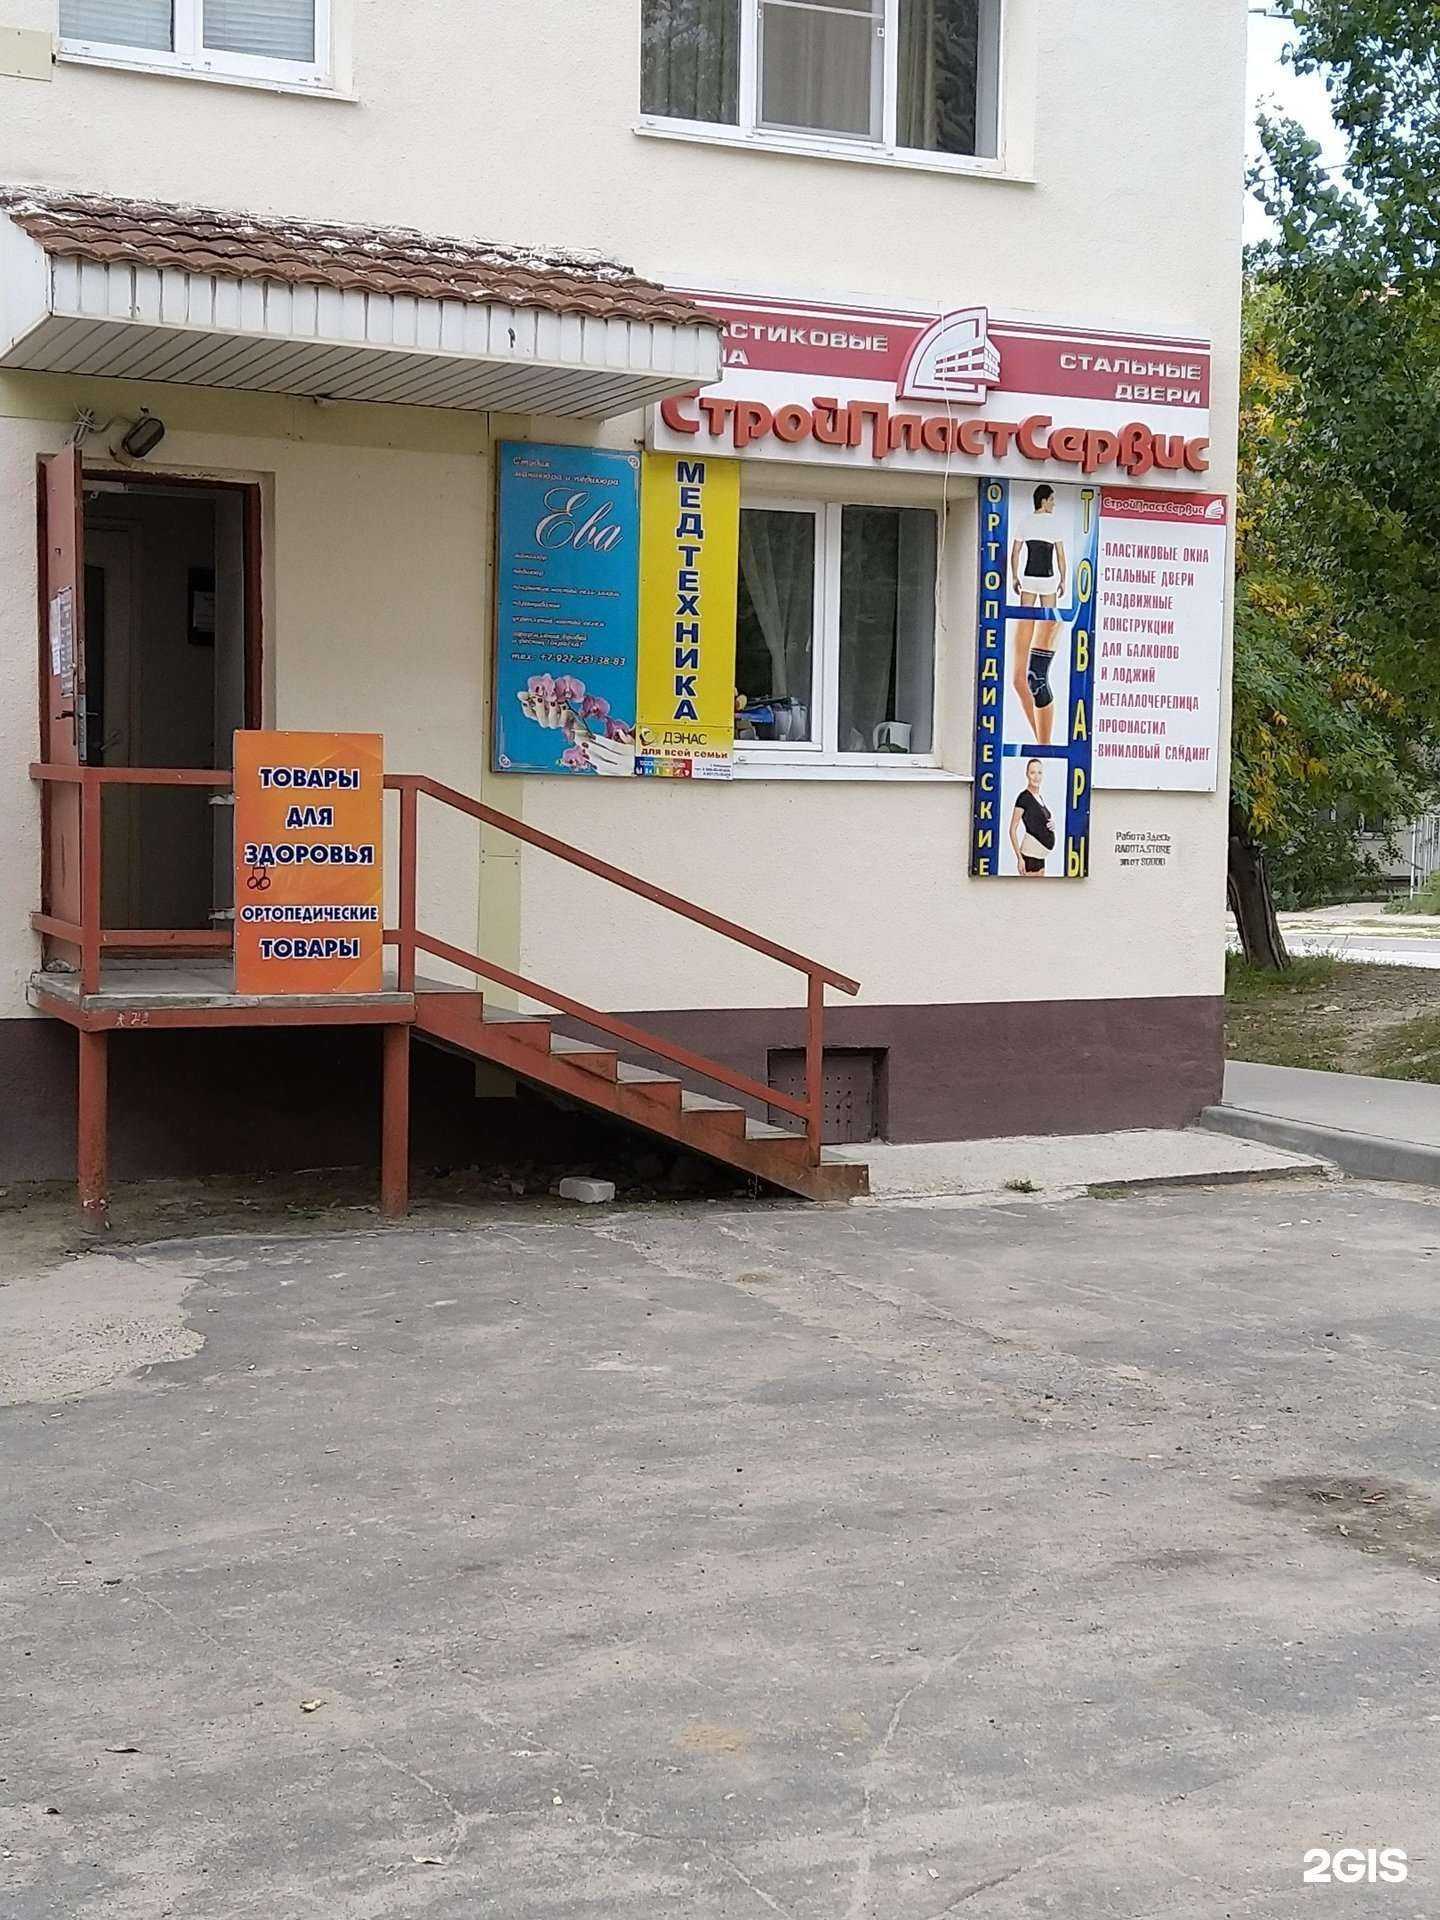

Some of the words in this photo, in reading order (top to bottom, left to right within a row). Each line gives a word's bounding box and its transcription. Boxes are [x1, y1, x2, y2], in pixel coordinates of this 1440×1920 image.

[1060, 352, 1201, 380] СТАЛЬНЫЕ
[1115, 383, 1201, 404] ДВЕРИ
[1183, 547, 1209, 563] ОКНА
[1161, 571, 1194, 587] ДВЕРИ
[673, 460, 706, 721] МЕДТЕХНИКА
[1103, 617, 1174, 635] КОНСТРУКЦИИ
[1101, 642, 1121, 658] ДЛЯ
[1127, 643, 1180, 659] БАЛКОНОВ
[978, 484, 1003, 876] ОРТОПЕДИЧЕСКИЕ
[1067, 488, 1095, 878] ТОВАРЫ
[1101, 667, 1108, 680] И
[1112, 667, 1156, 684] ЛОДЖИЙ
[662, 731, 708, 745] ДЭНАС
[665, 748, 691, 758] всей
[694, 751, 728, 759] семьи
[1165, 744, 1210, 762] САЙДИНГ
[260, 767, 360, 789] ТОВАРЫ
[286, 806, 333, 829] ДЛЯ
[245, 843, 374, 866] ЗДОРОВЬЯ
[241, 906, 378, 923] ОРТОПЕДИЧЕСКИЕ
[260, 938, 360, 960] ТОВАРЫ
